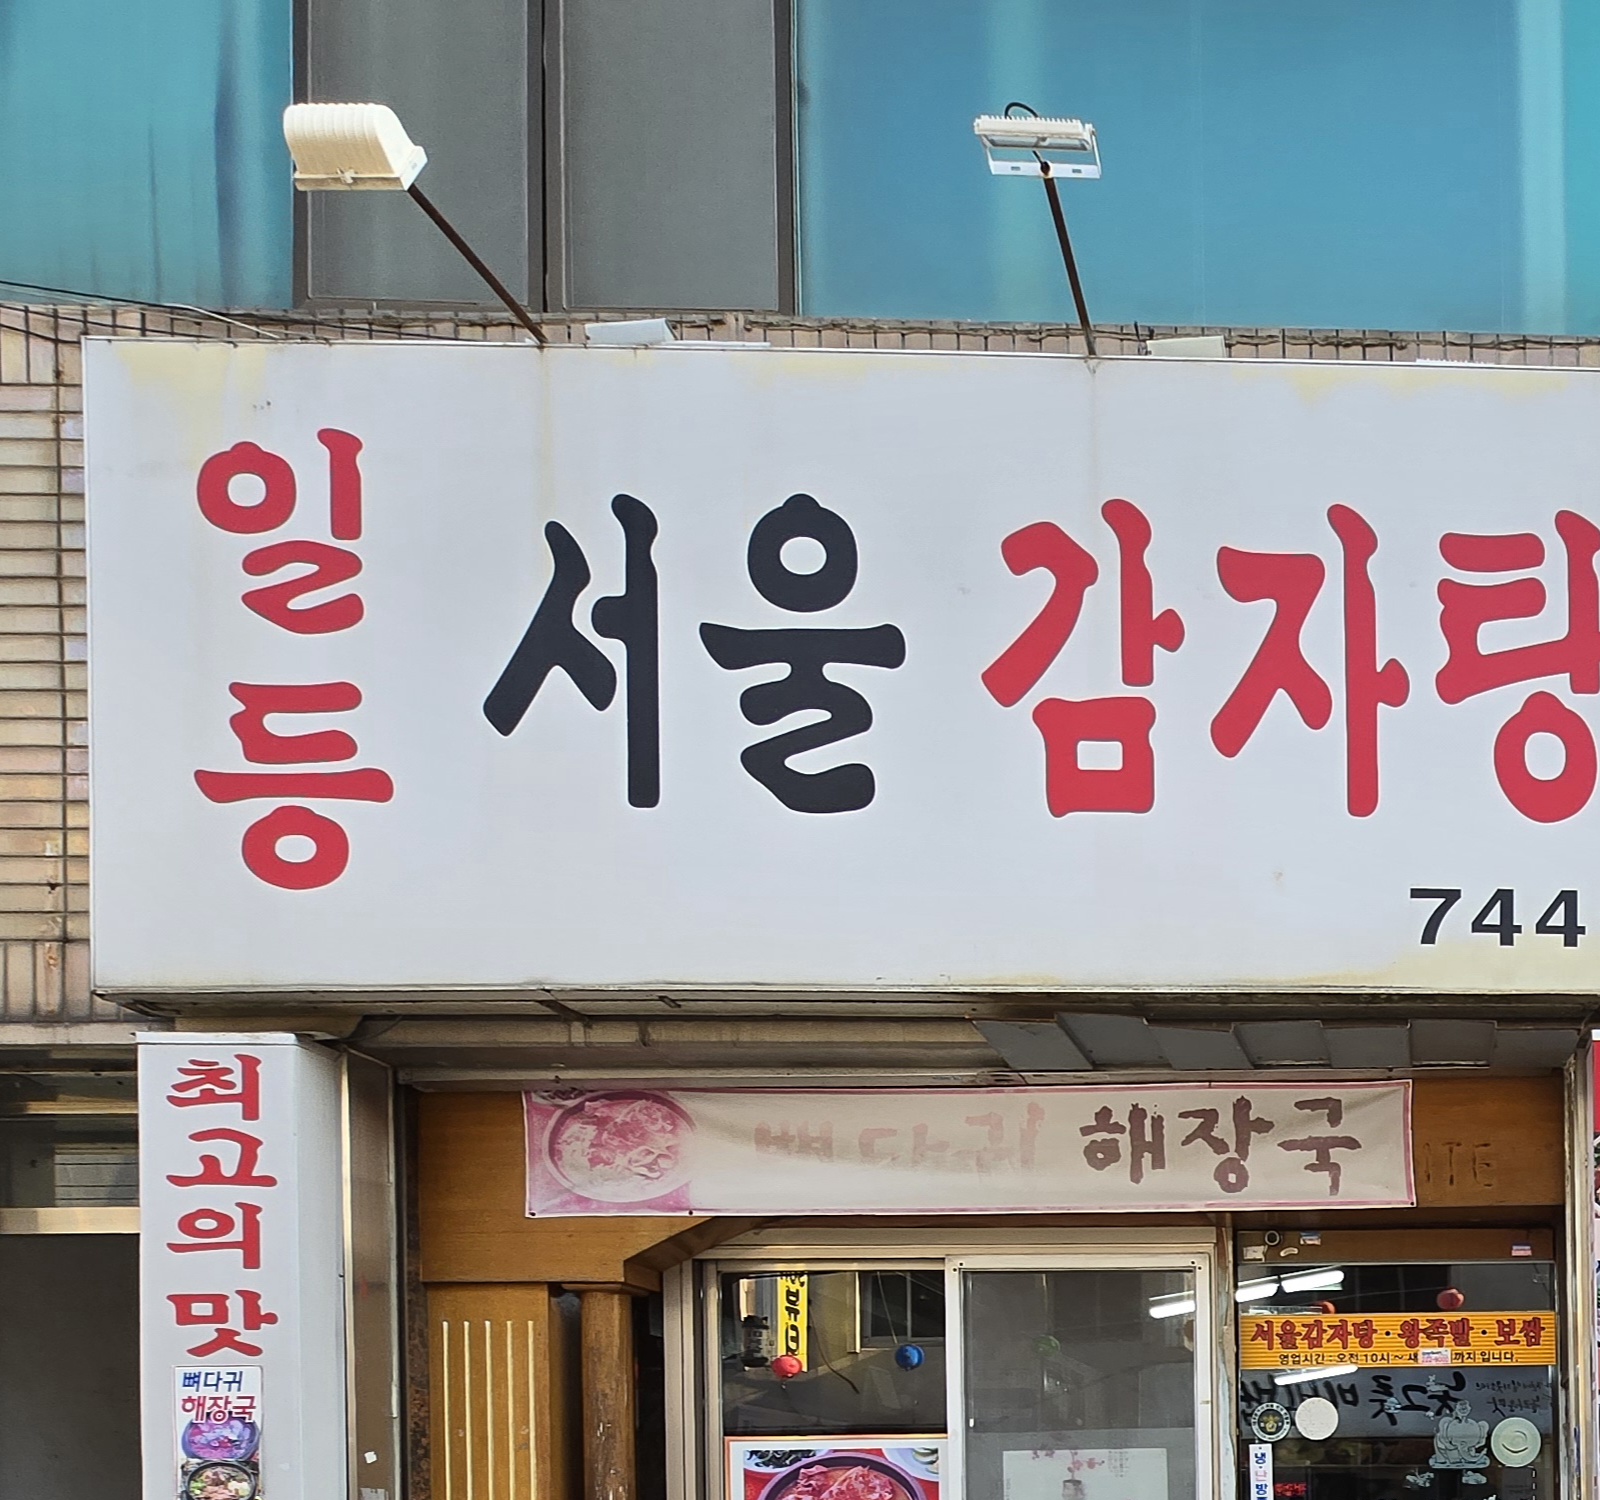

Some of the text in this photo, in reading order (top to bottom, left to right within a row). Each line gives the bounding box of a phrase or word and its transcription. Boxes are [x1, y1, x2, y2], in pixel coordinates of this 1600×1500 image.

[195, 427, 394, 891] 일등
[483, 493, 906, 814] 서울
[1079, 1095, 1362, 1197] 해장국
[166, 1054, 279, 1357] 최고의 맛
[182, 1371, 243, 1392] 뼈다귀
[1250, 1317, 1546, 1350] 서울감자탕 왕족발 보쌈
[181, 1395, 257, 1422] 해장국
